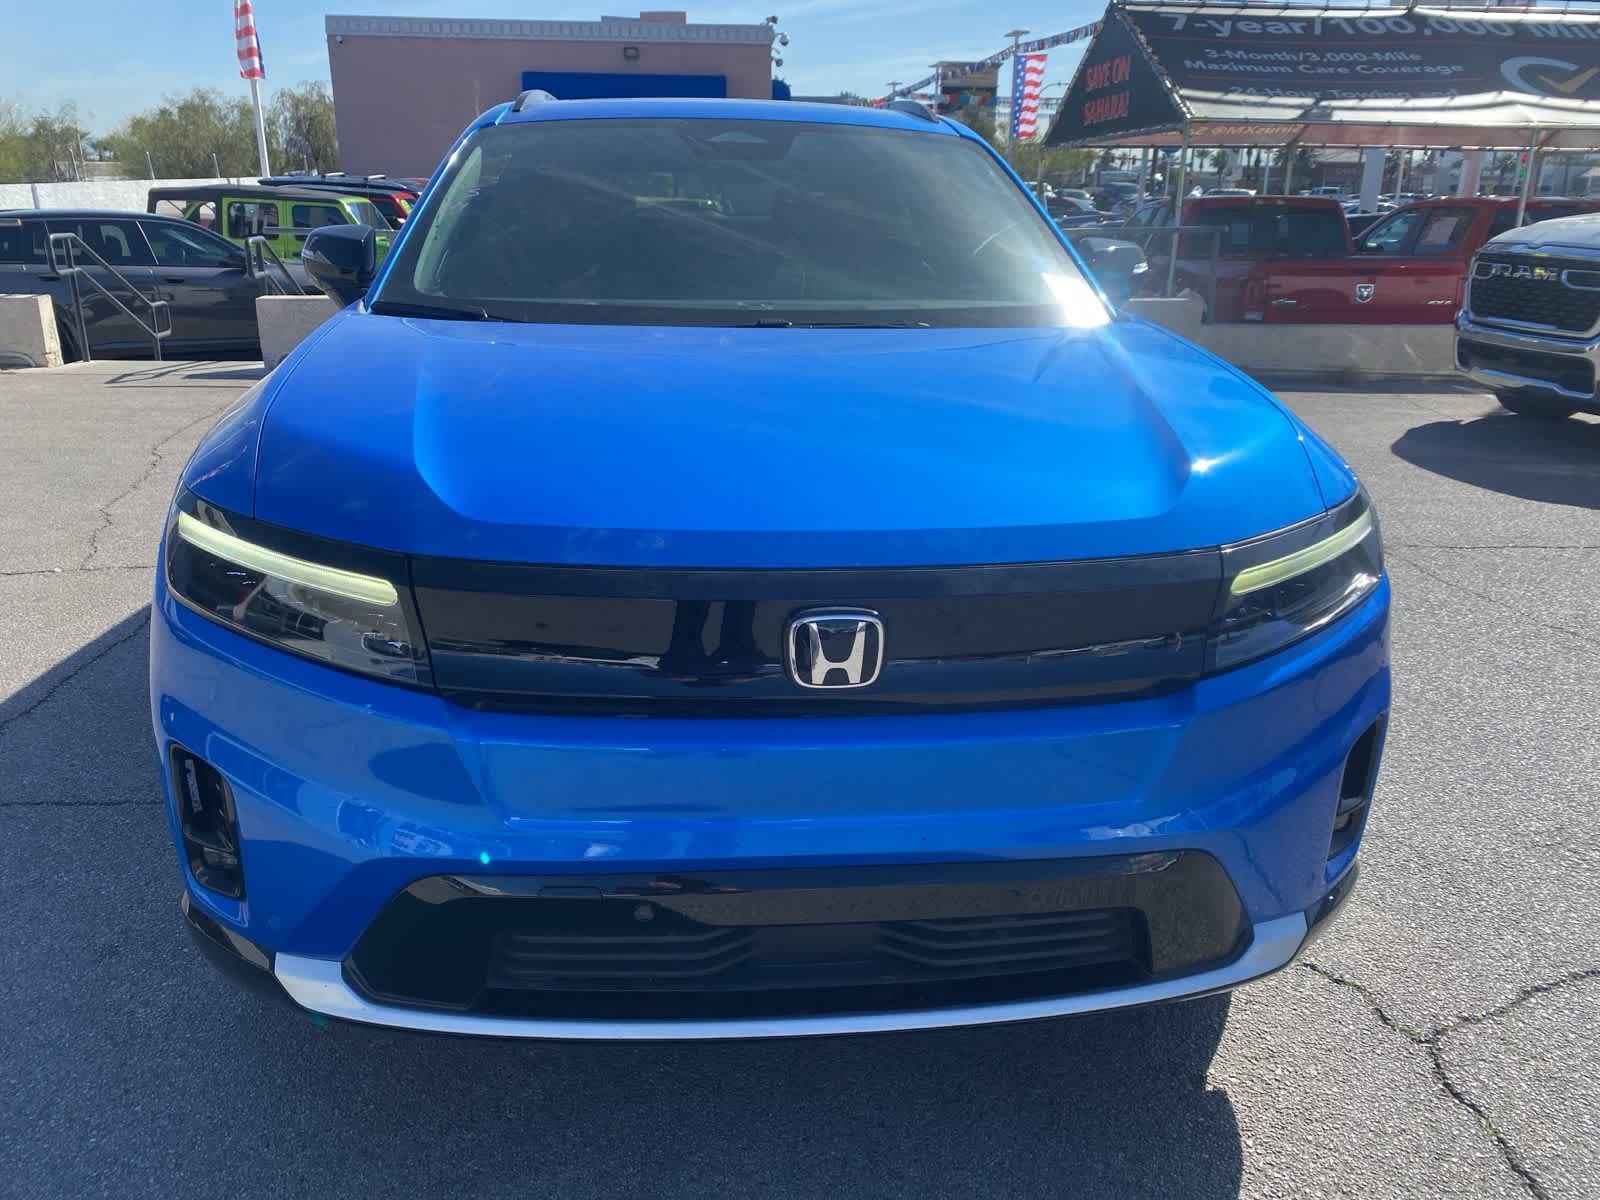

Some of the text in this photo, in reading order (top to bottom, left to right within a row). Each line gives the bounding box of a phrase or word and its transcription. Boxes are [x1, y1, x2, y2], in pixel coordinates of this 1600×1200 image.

[1112, 54, 1131, 84] ON
[1183, 59, 1465, 75] Maximum Care Coverage
